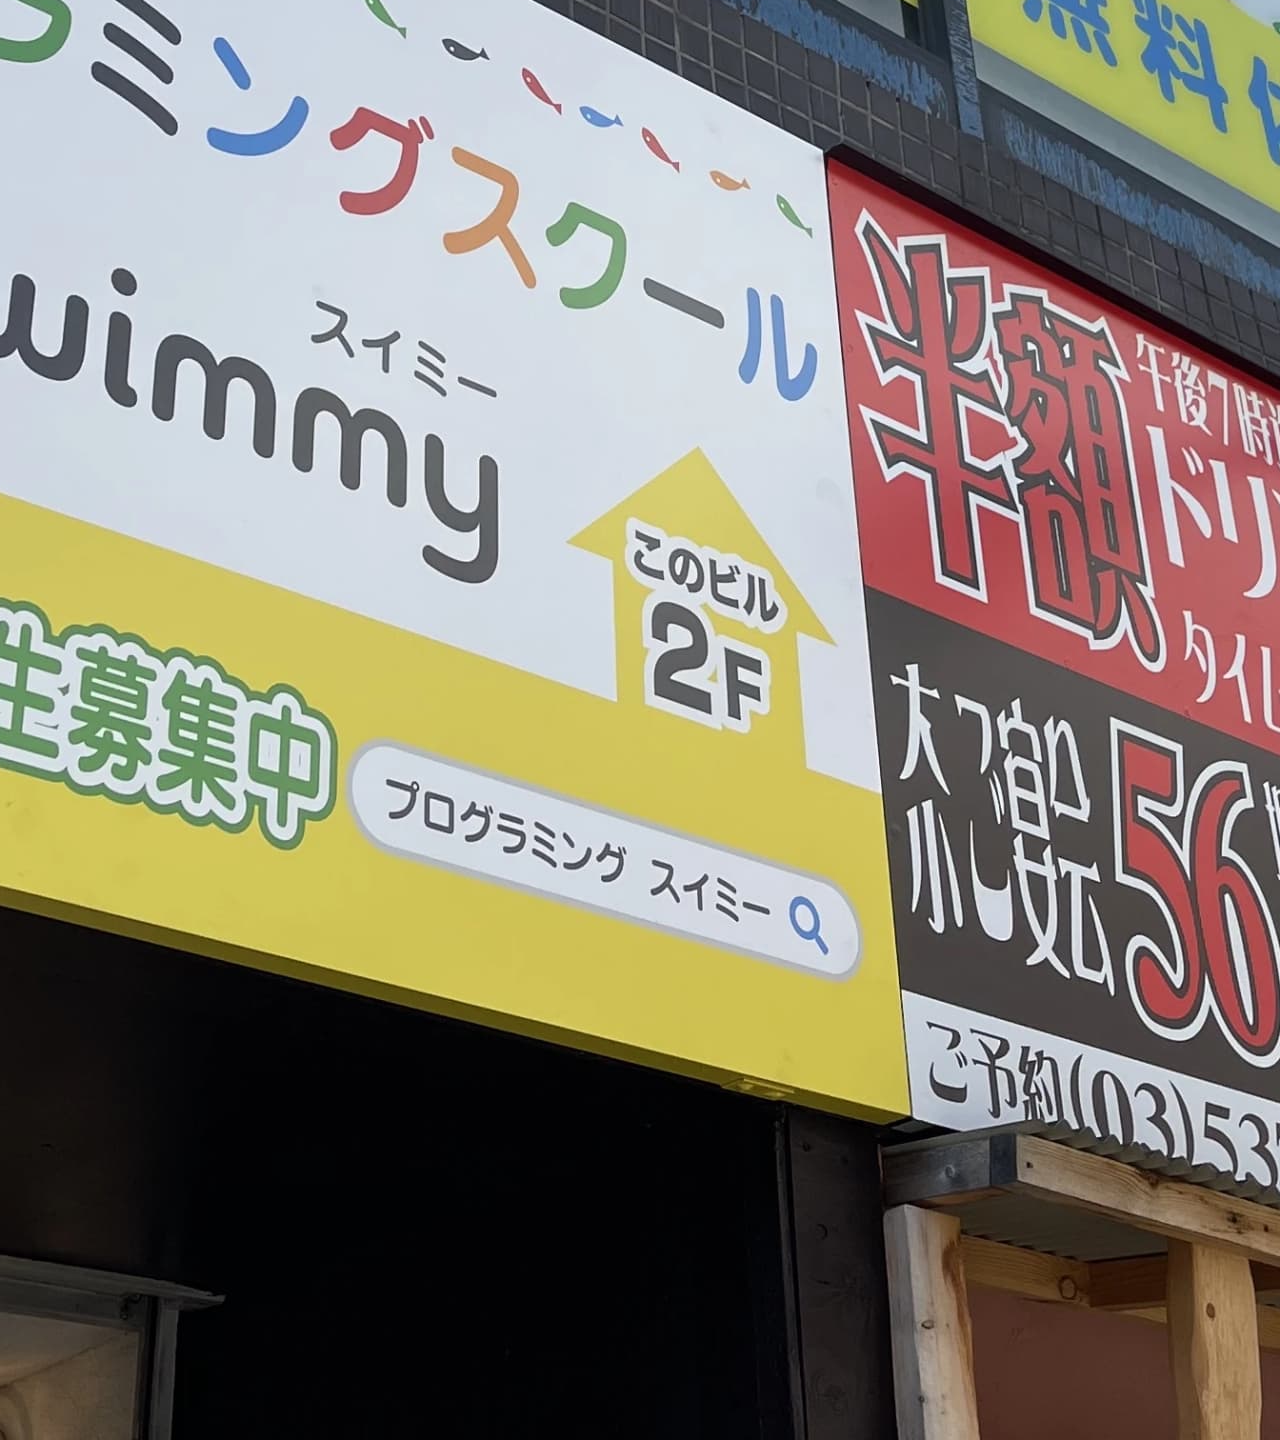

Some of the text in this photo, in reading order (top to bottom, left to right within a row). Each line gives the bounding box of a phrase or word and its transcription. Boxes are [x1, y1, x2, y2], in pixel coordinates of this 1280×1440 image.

[311, 300, 498, 398] スイミー
[854, 208, 1167, 672] 半額
[632, 528, 779, 623] このビル
[651, 601, 763, 721] 2F
[385, 777, 771, 922] プログラミング スイミー
